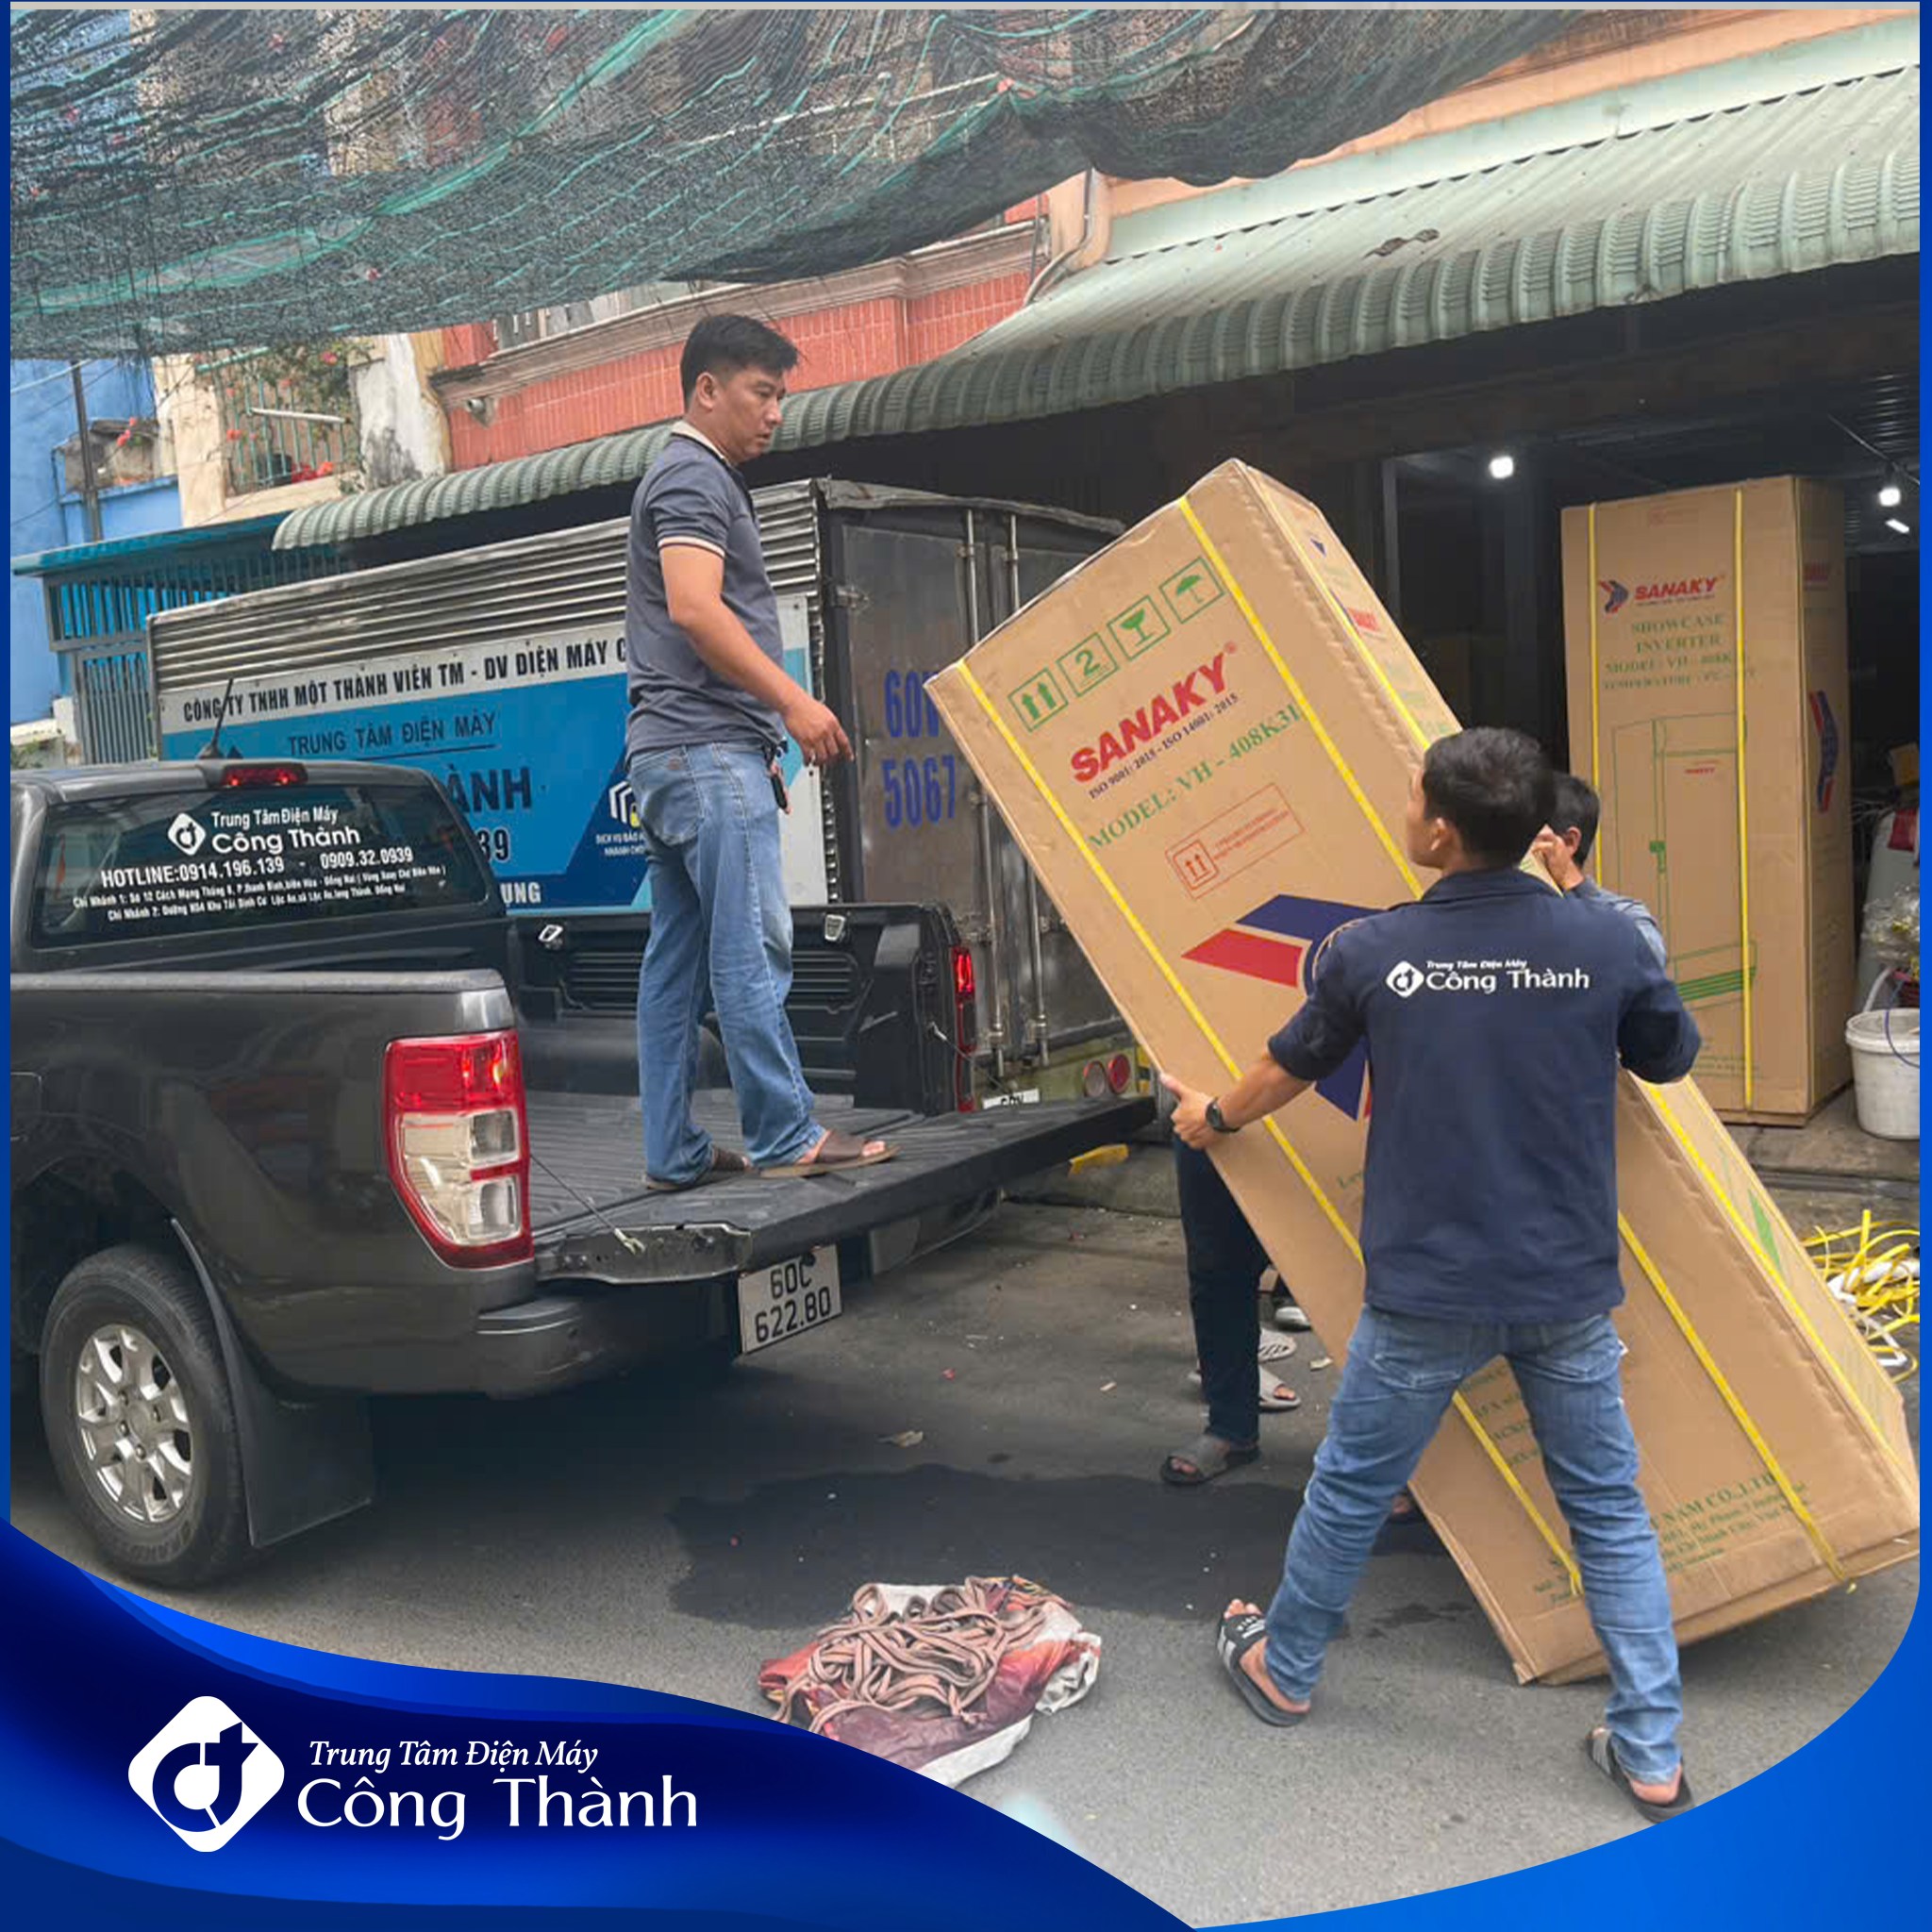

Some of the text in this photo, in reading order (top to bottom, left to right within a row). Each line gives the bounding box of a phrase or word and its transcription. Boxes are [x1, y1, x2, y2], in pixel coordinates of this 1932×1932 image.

[1634, 577, 1717, 600] SANAKY
[1632, 614, 1724, 634] SHOWCASE
[1637, 634, 1723, 654] INVERTER
[183, 697, 223, 723] CÔNG
[225, 693, 244, 717] TY
[249, 688, 289, 714] TNHH
[294, 678, 327, 708] MỘT
[333, 672, 388, 702] THÀNH
[392, 662, 432, 693] VIÊN
[438, 661, 464, 687] TM
[484, 655, 509, 681] DV
[566, 638, 608, 669] MÁY
[288, 709, 496, 756] TRUNG TÂM ĐIỆN MÁY
[1069, 652, 1226, 784] SANAKY
[1088, 781, 1109, 801] ISO
[1162, 730, 1183, 751] ISO
[1175, 760, 1213, 791] VH
[447, 763, 533, 814] ÀNH
[881, 755, 956, 828] 5067
[211, 805, 339, 830] Trung Tâm Điện Máy
[211, 825, 361, 856] Công Thành
[100, 856, 285, 889] HOTLINE:0914.196.139
[320, 845, 414, 871] 0909.32.0939
[1425, 959, 1455, 972] Trung
[1425, 968, 1590, 994] Công Thành
[770, 1259, 812, 1300] 60C
[755, 1286, 831, 1343] 622.80
